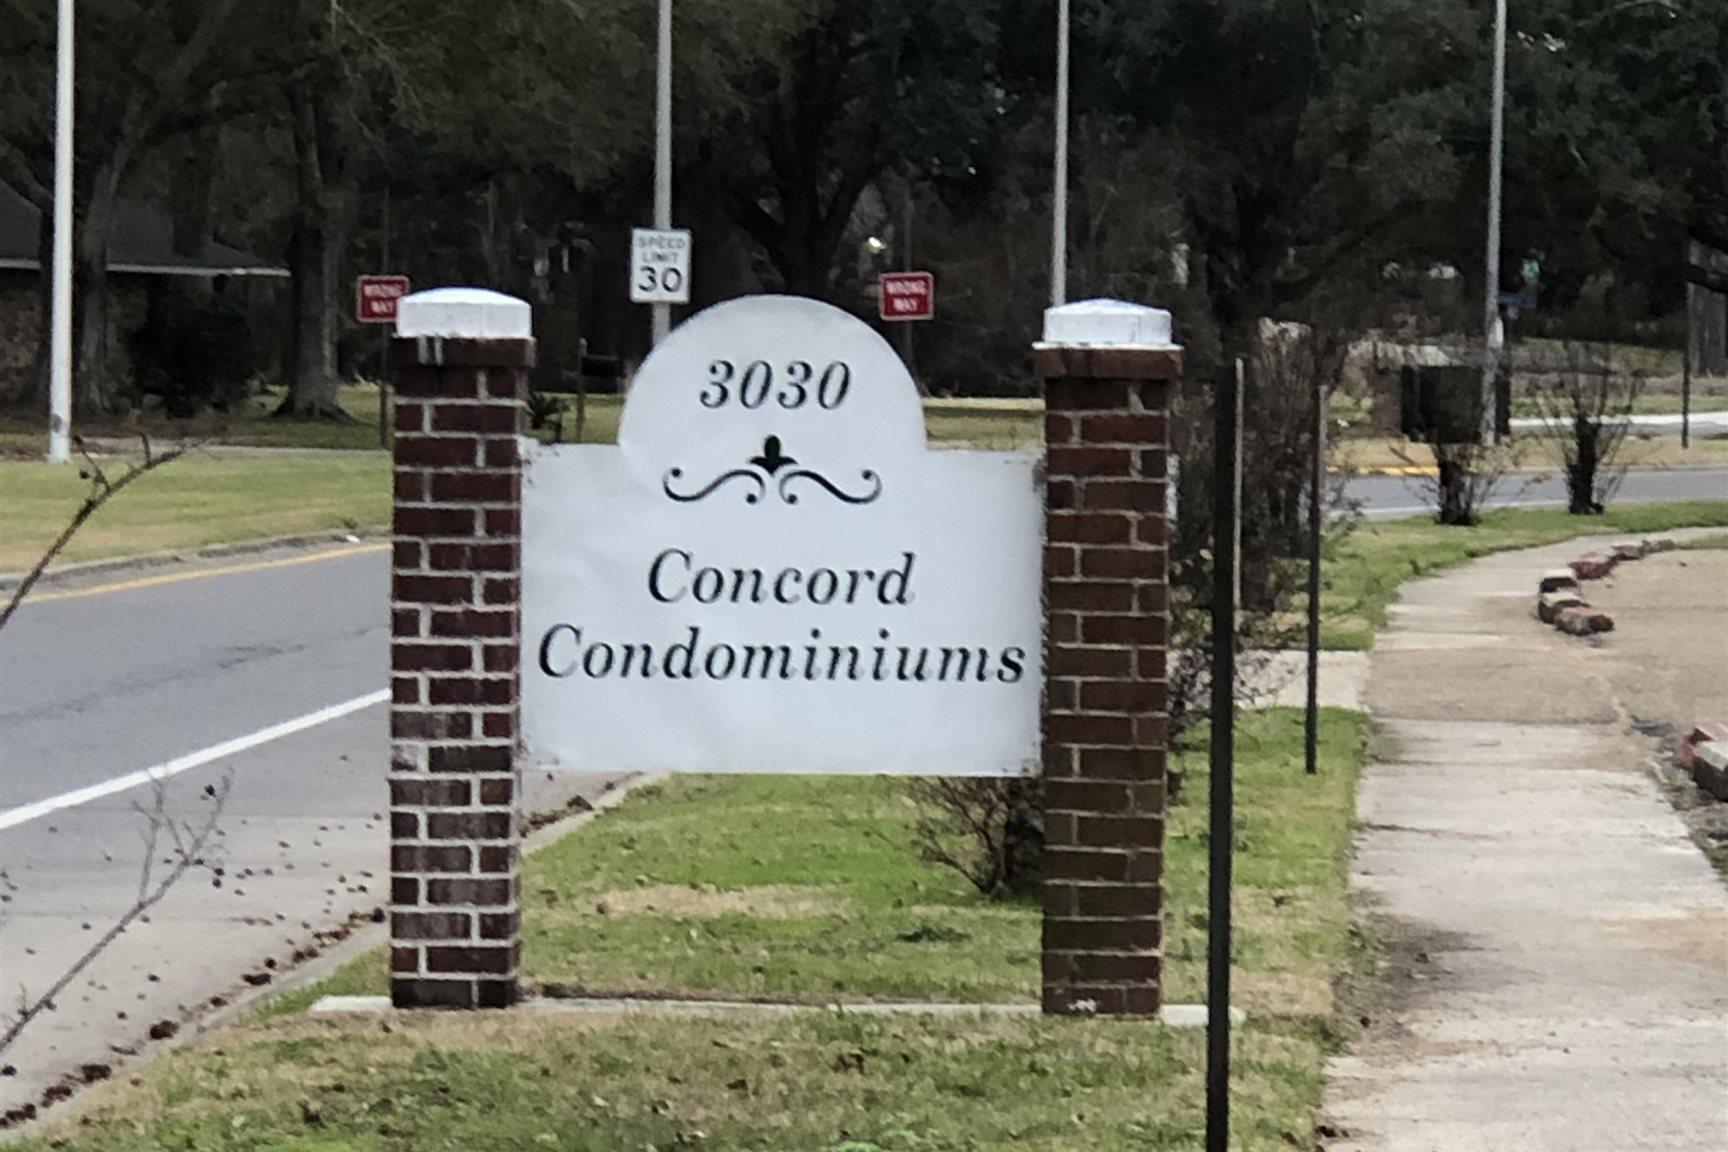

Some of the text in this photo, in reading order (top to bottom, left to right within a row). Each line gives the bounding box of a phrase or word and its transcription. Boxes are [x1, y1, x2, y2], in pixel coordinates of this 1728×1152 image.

[639, 236, 685, 249] SPEED
[642, 252, 678, 263] LIMIT
[638, 266, 682, 292] 30
[699, 360, 851, 410] 3030
[648, 549, 915, 605] Concord
[538, 624, 1026, 684] Condominiums
